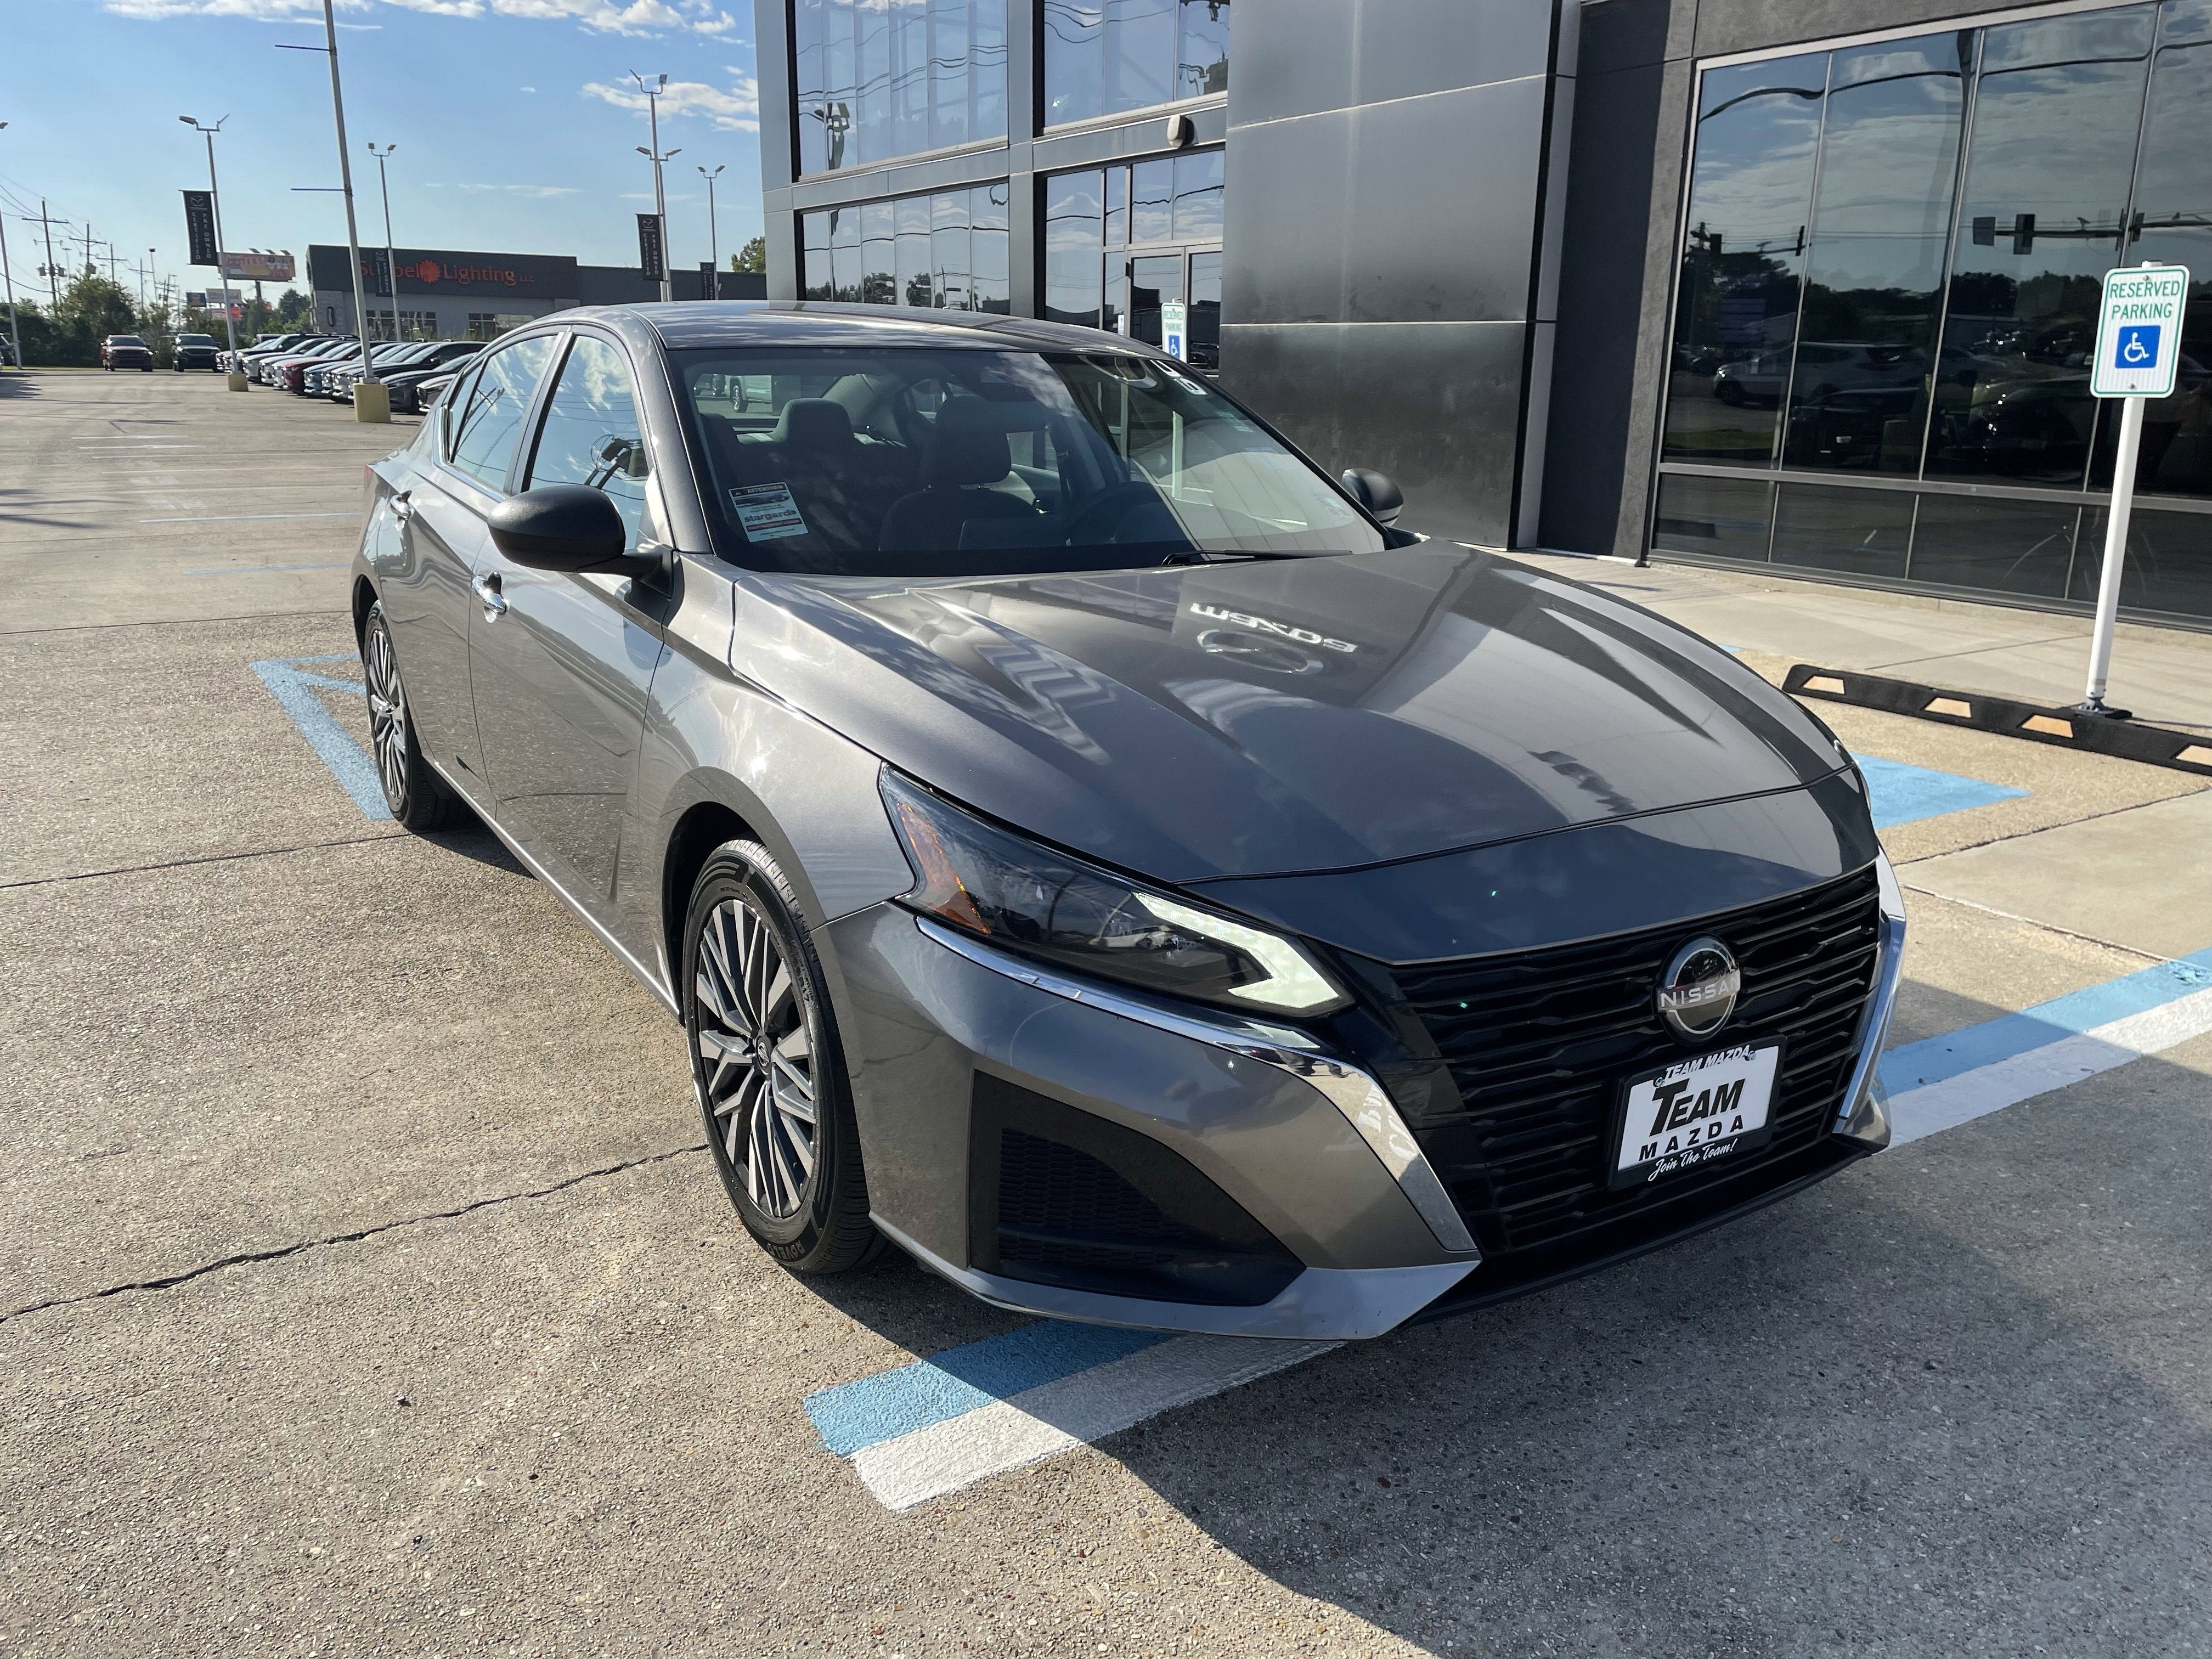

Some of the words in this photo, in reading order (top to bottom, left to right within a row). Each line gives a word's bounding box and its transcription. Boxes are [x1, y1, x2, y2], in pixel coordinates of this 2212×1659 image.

[443, 263, 517, 286] Lighting
[2110, 280, 2180, 298] RESERVED
[2112, 303, 2173, 320] PARKING
[744, 509, 791, 522] stargard
[1661, 977, 1739, 1007] NISSAN
[1664, 1058, 1703, 1080] TEAM
[1702, 1045, 1750, 1069] MAZDA
[1649, 1078, 1746, 1137] TEAM
[1639, 1115, 1743, 1161] MAZDA
[1647, 1158, 1679, 1182] Join
[1680, 1149, 1701, 1167] The
[1702, 1138, 1738, 1160] Team!
[767, 1240, 806, 1260] ROVELO
